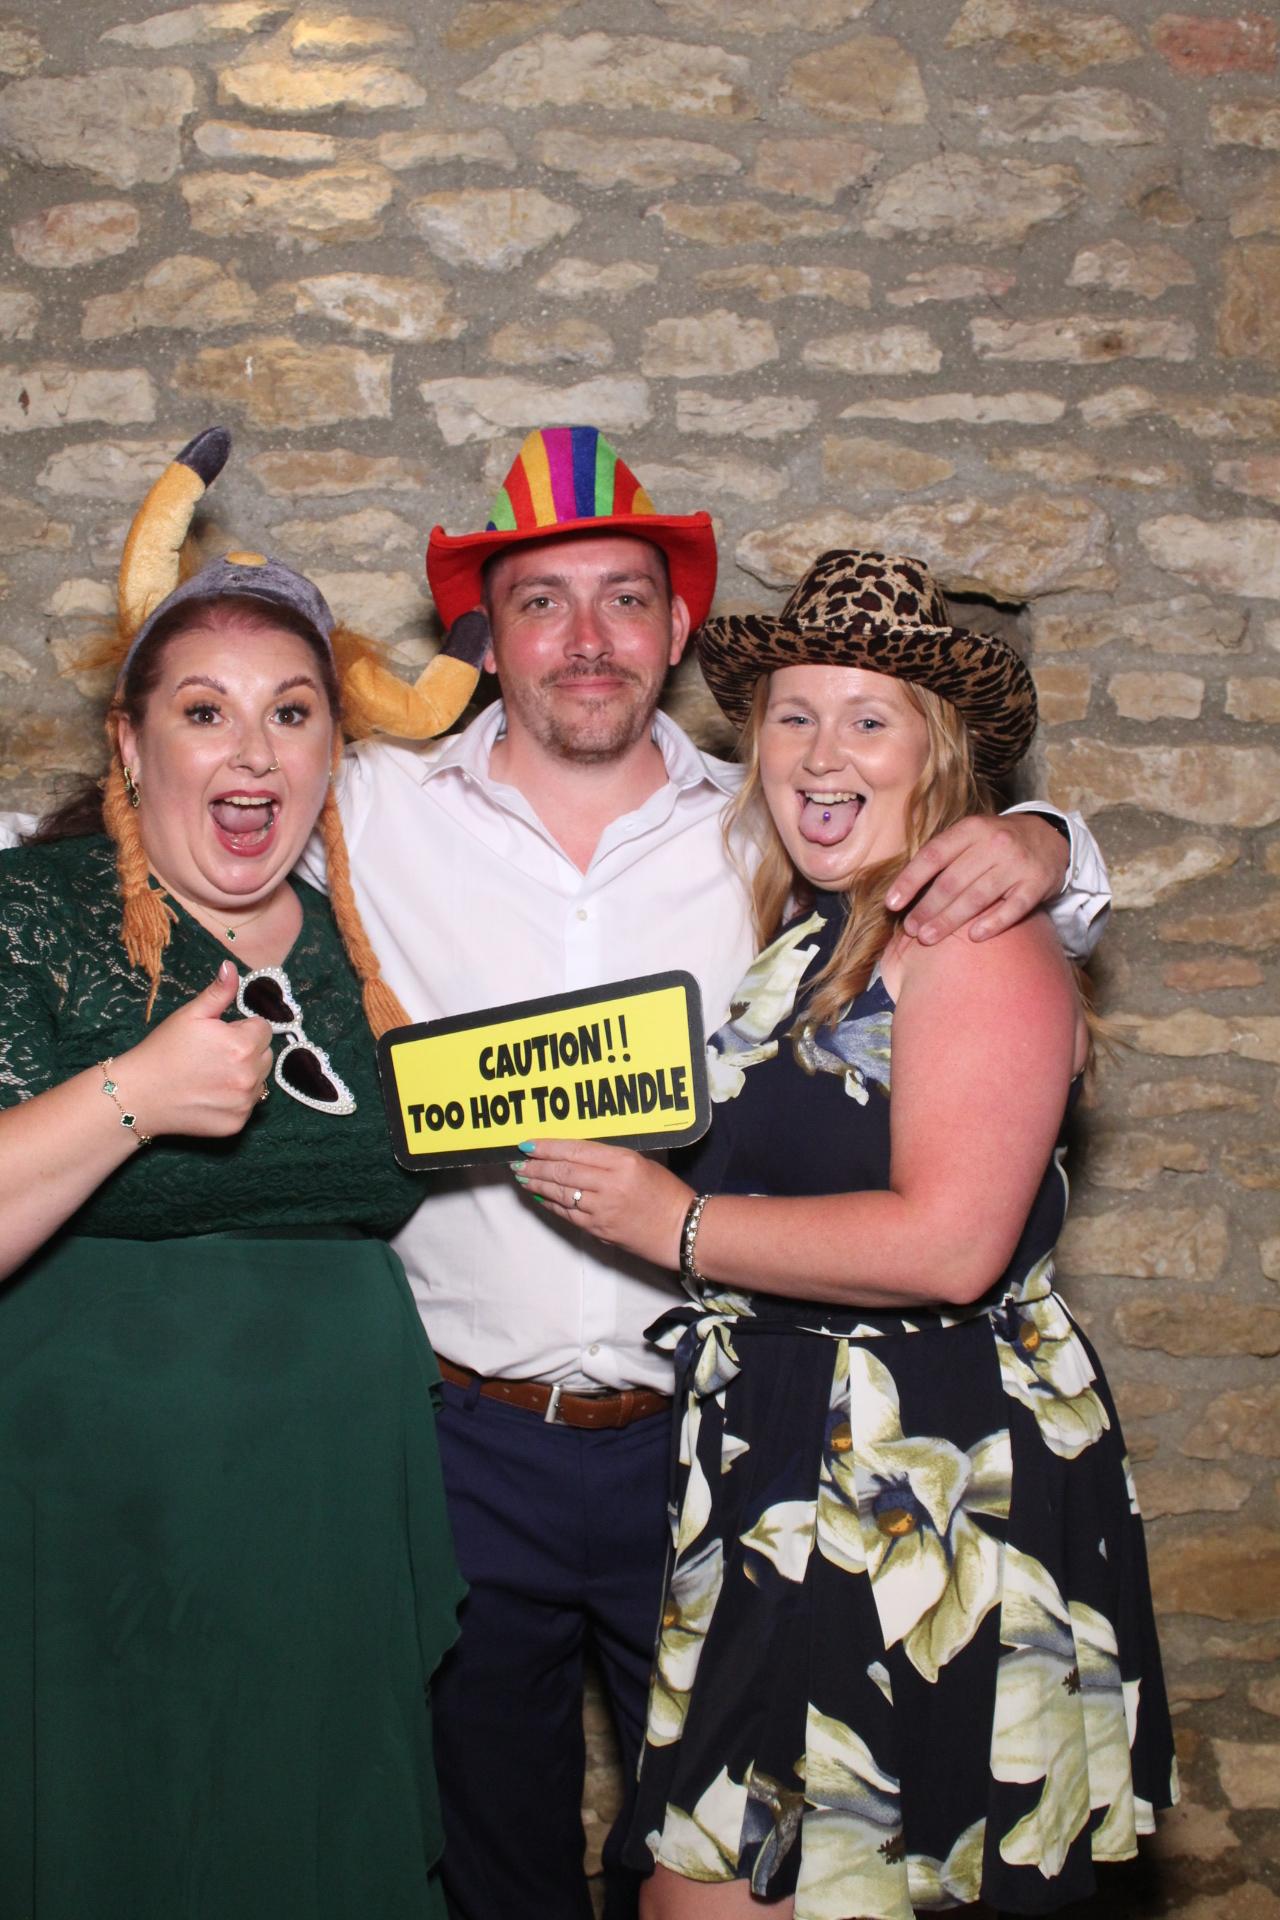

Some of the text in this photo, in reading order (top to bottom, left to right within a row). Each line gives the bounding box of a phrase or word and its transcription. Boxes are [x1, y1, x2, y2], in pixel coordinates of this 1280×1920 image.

[479, 1015, 631, 1080] CAUTION!!
[408, 1066, 690, 1133] TOO HOT TO HANDLE
